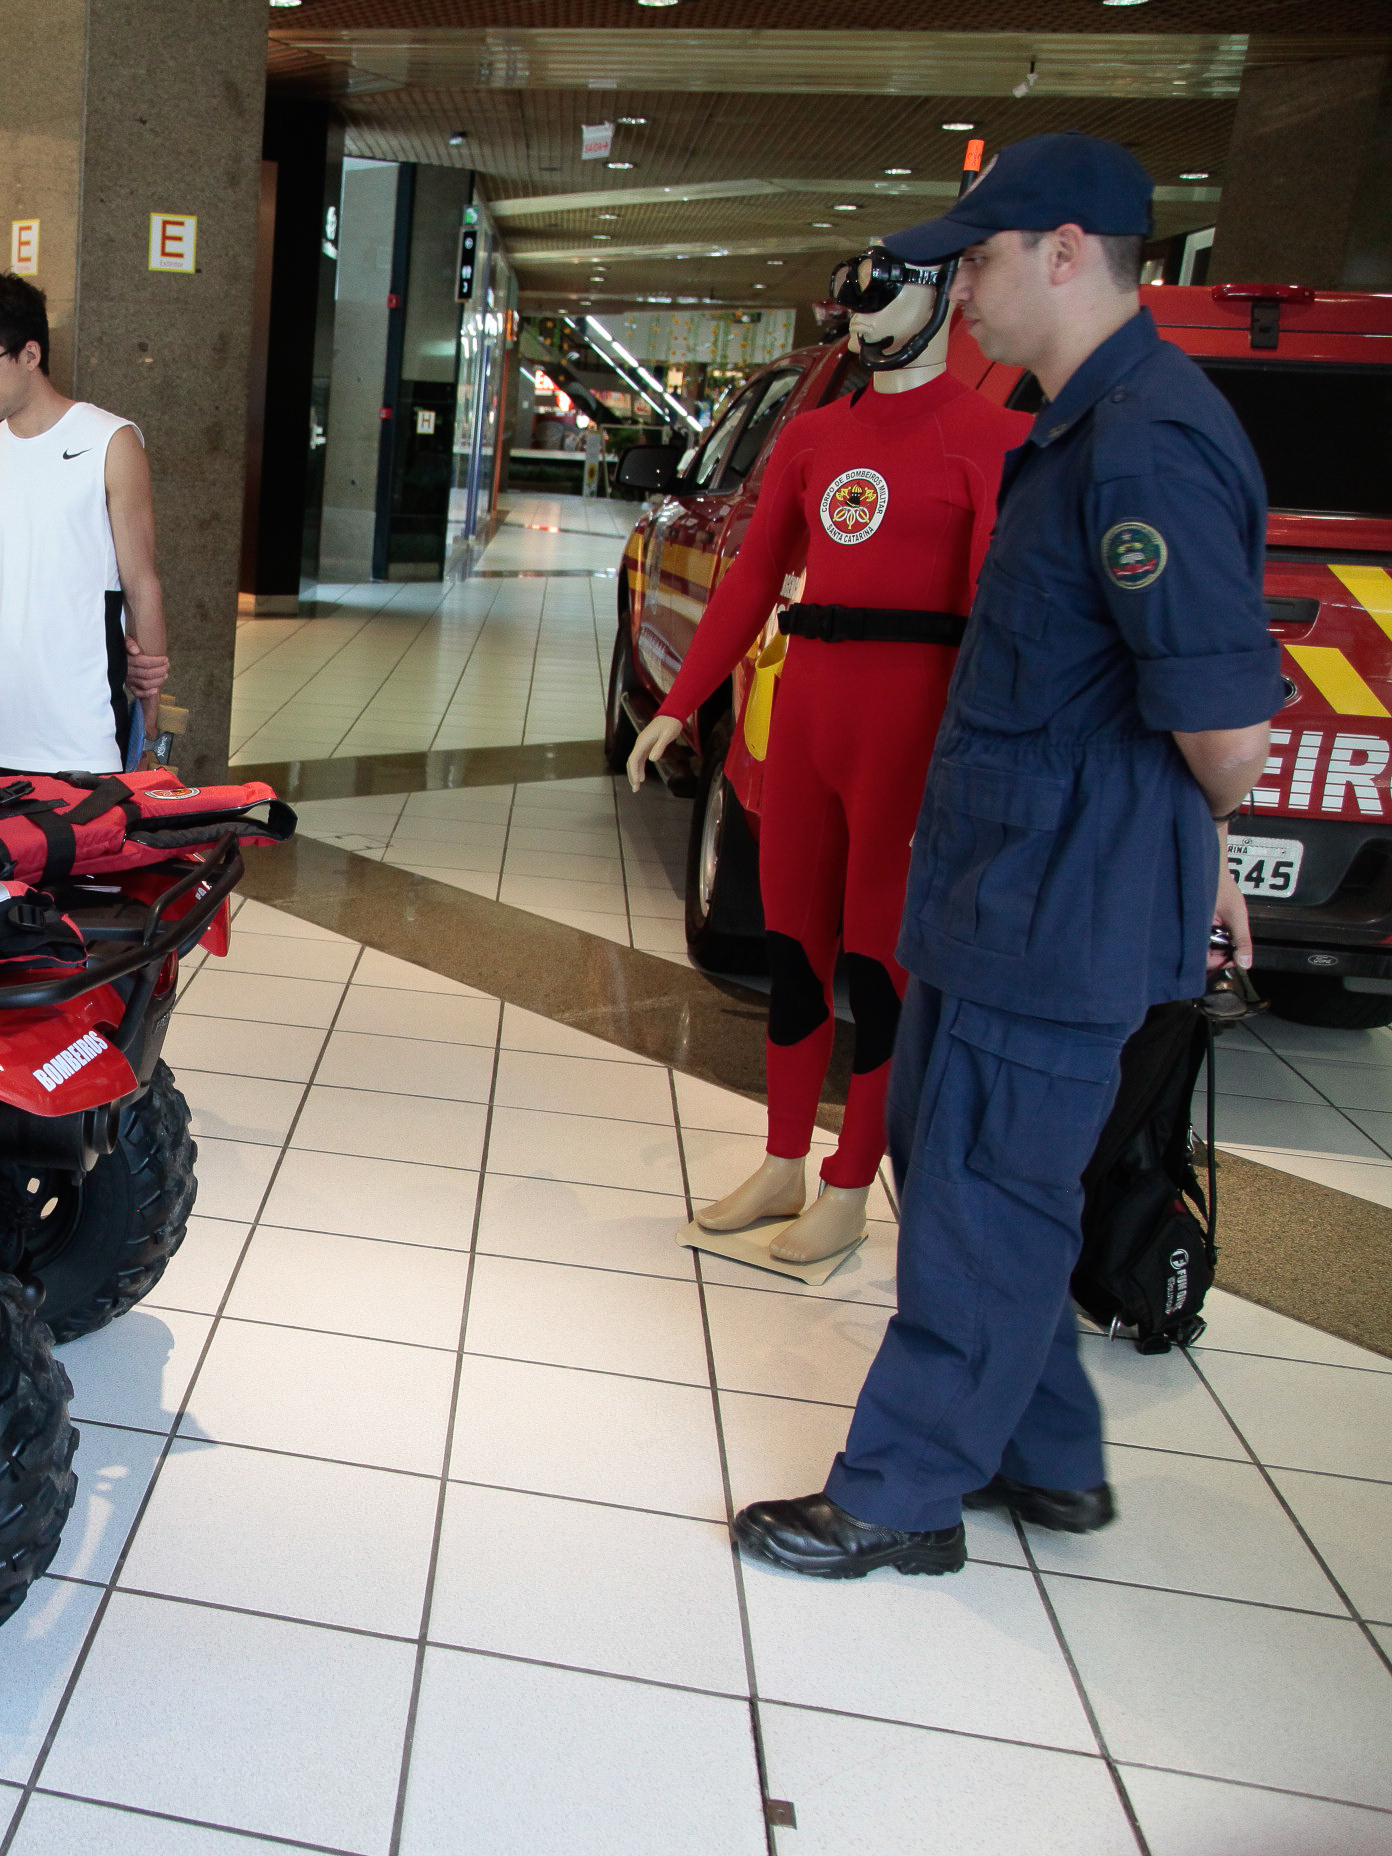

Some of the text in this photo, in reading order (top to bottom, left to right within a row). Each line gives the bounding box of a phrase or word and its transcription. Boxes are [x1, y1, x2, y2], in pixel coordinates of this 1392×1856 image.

[17, 224, 33, 263] E
[160, 219, 185, 258] E
[821, 470, 887, 515] CORPO DE BOMBEIROS MILITAR
[827, 523, 874, 543] SANTA CATARINA
[32, 1030, 108, 1092] BOMBEIROS
